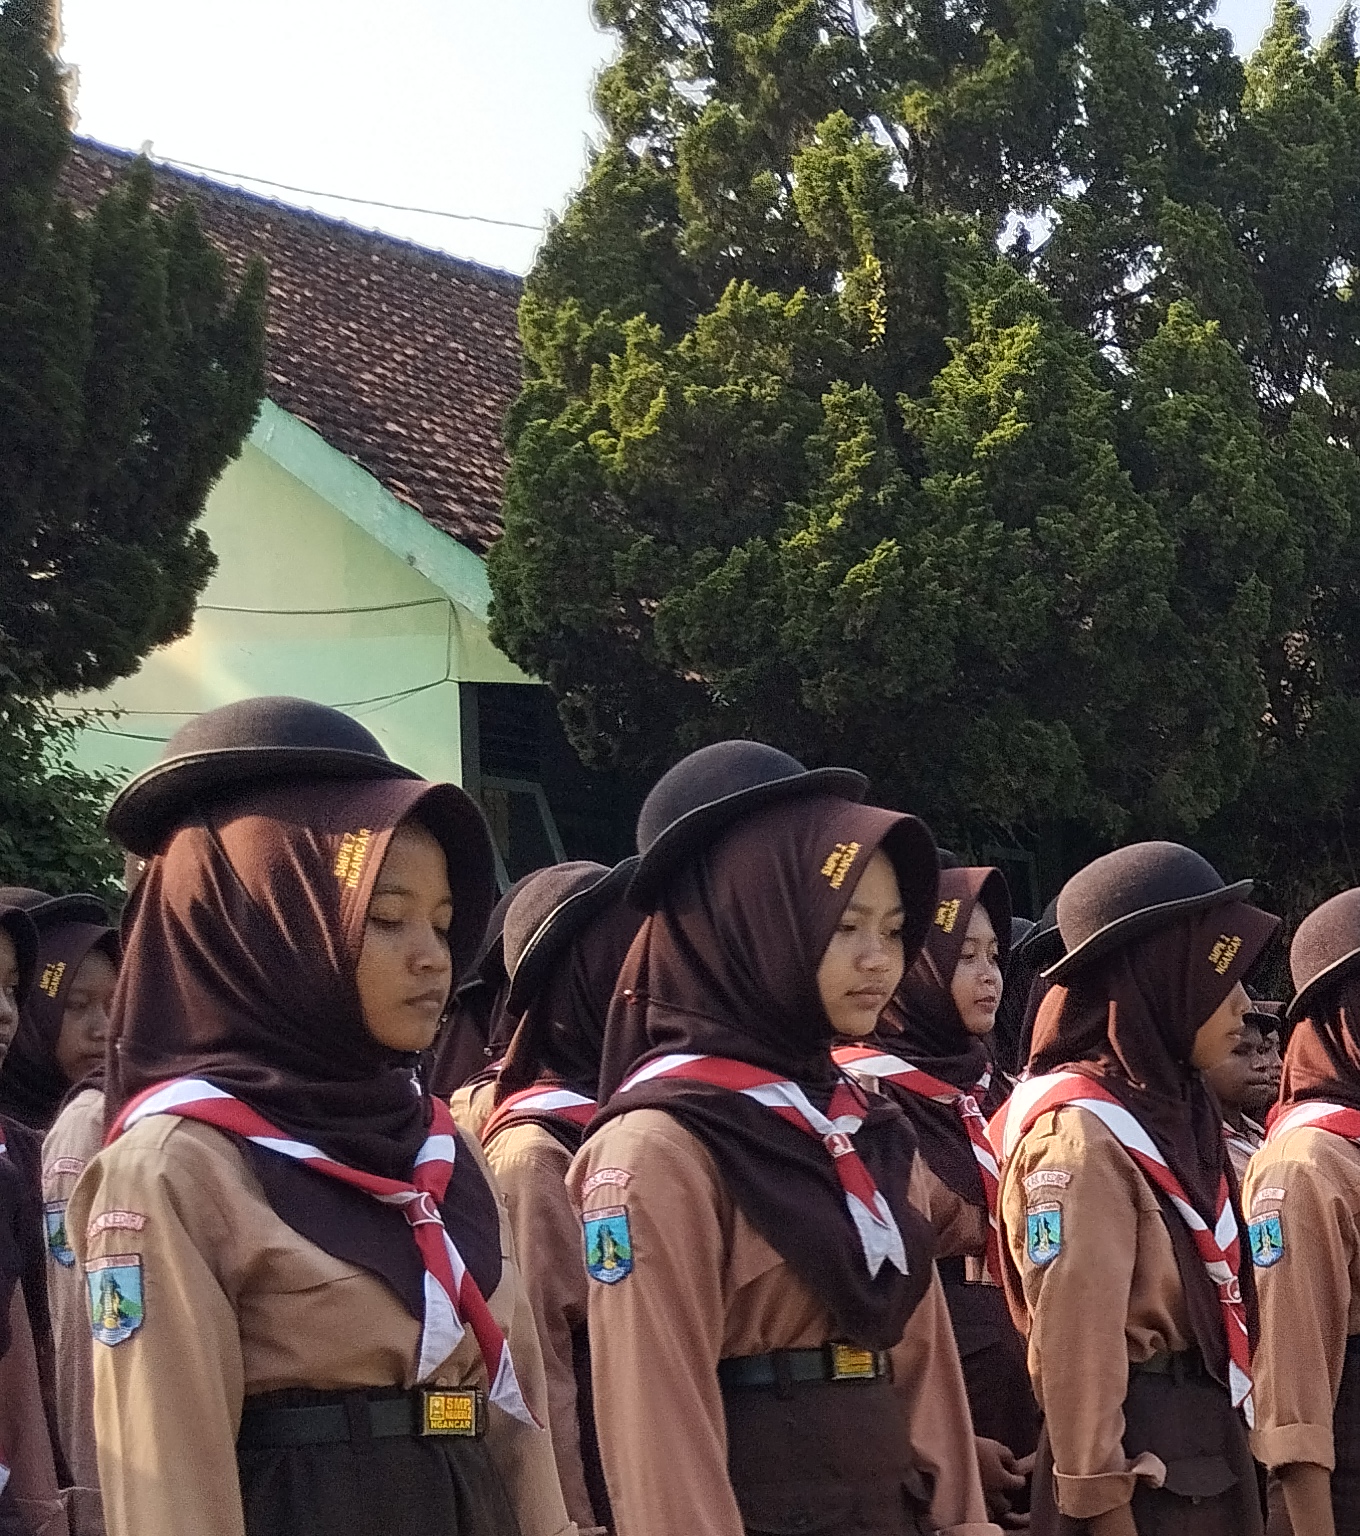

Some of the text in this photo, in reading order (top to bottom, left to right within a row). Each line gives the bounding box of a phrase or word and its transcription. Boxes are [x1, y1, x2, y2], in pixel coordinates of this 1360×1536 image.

[334, 832, 356, 877] SMPN 2
[346, 828, 372, 888] NGANCAR
[1214, 935, 1242, 975] NGANCAR
[446, 1398, 471, 1410] SMP
[431, 1421, 471, 1429] NGANCAR
